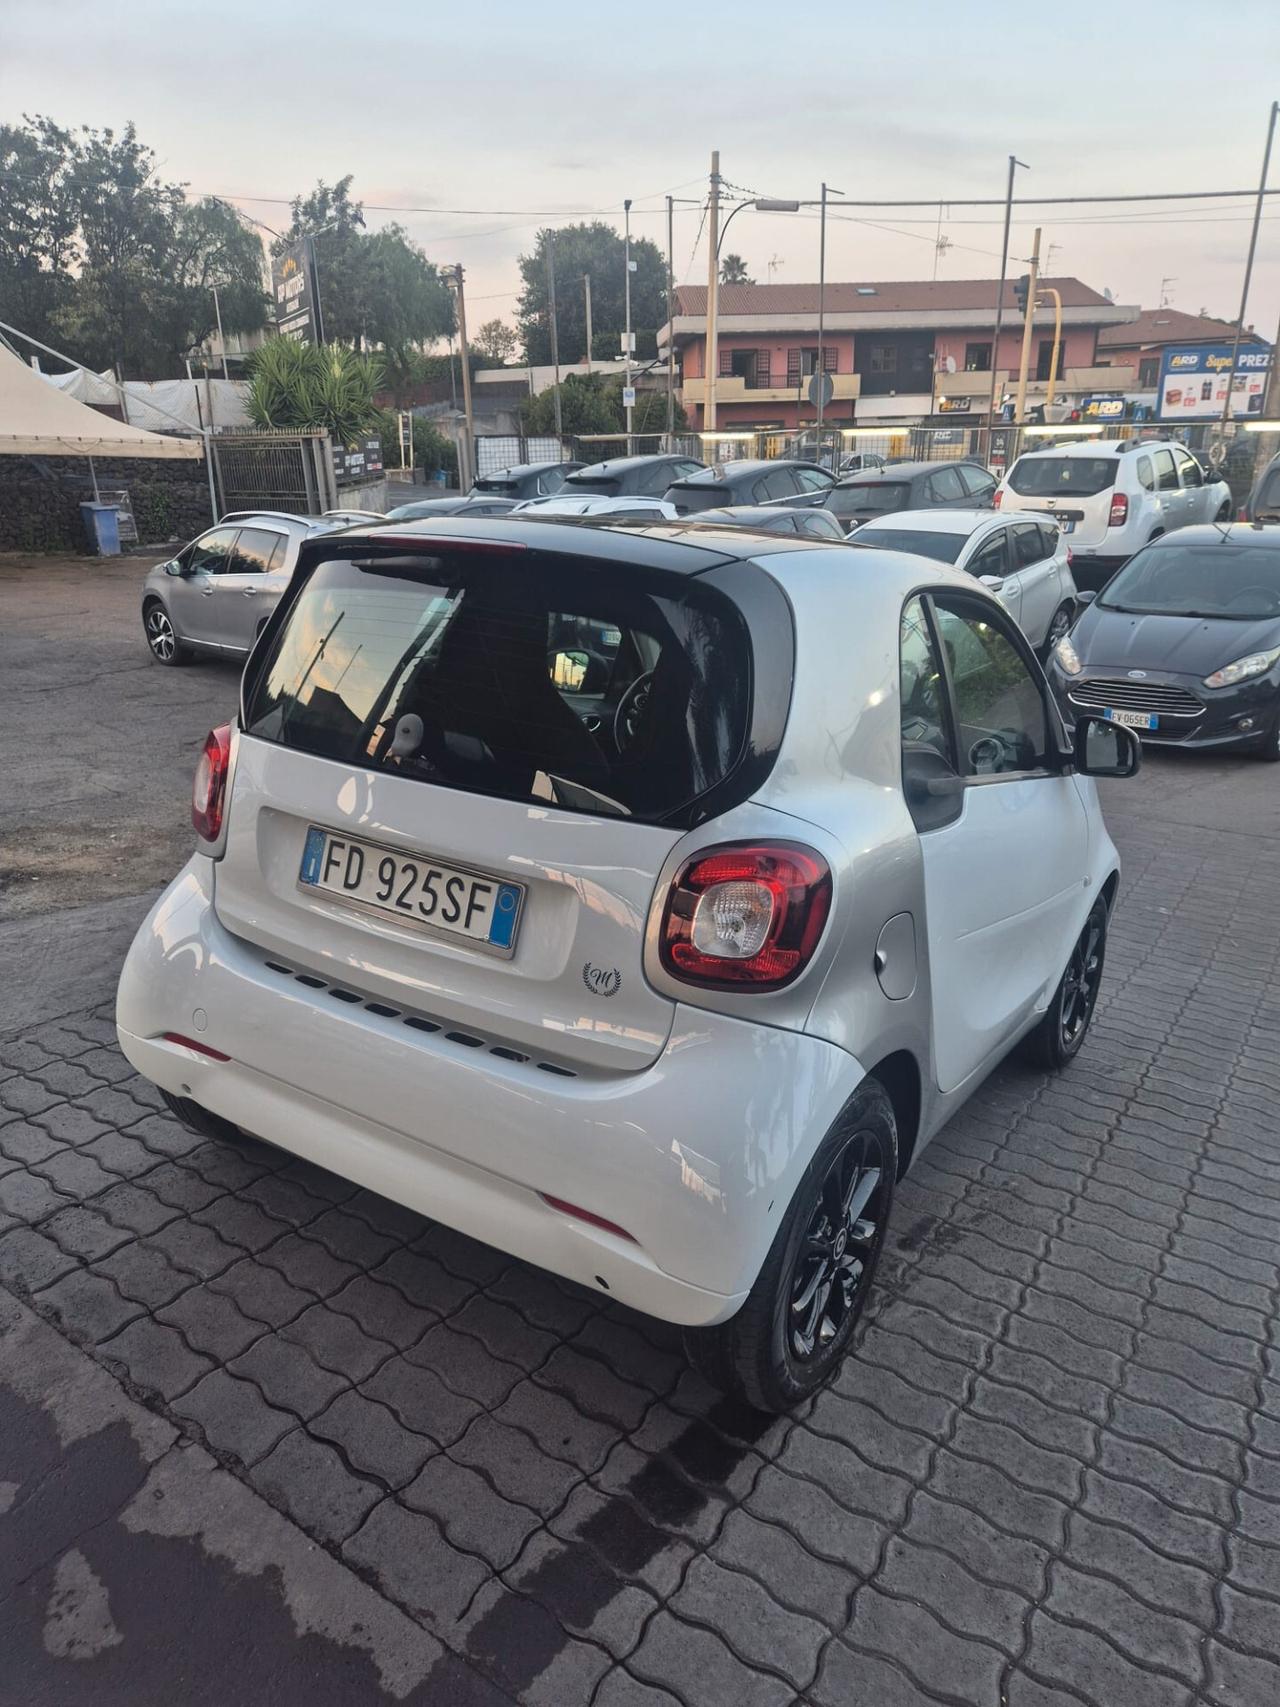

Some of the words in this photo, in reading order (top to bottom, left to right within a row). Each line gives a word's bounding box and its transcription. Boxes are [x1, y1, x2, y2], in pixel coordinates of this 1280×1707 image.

[1205, 354, 1233, 371] Supe
[323, 839, 365, 891] FD
[376, 856, 492, 929] 925SF
